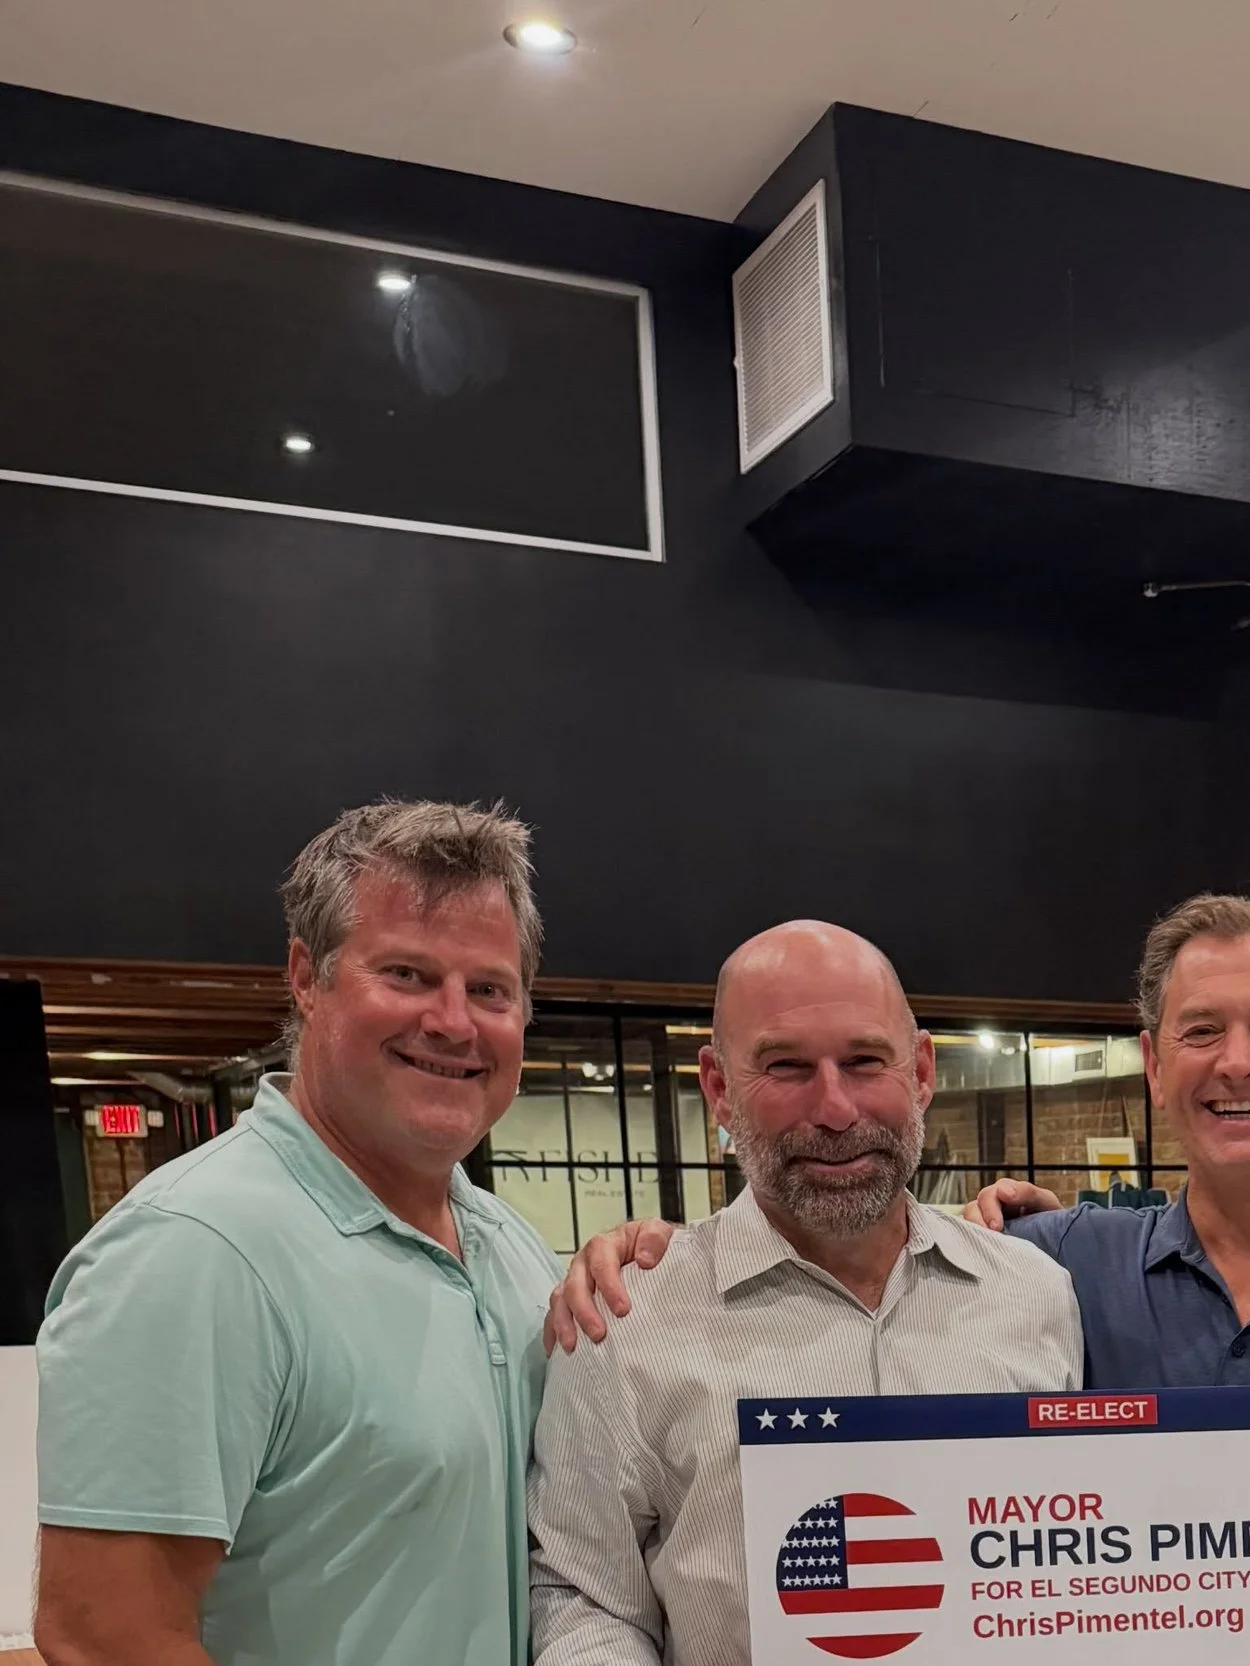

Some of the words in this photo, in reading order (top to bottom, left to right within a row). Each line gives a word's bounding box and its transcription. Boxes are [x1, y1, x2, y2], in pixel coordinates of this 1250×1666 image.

[102, 1105, 139, 1133] EXIT
[1038, 1401, 1148, 1421] RE-ELECT
[968, 1493, 1104, 1525] MAYOR
[970, 1525, 1133, 1569] CHRIS
[971, 1580, 1023, 1601] FOR
[1031, 1578, 1061, 1598] EL
[1068, 1572, 1191, 1597] SEGUNDO
[973, 1603, 1245, 1639] ChrisPimentel.org
